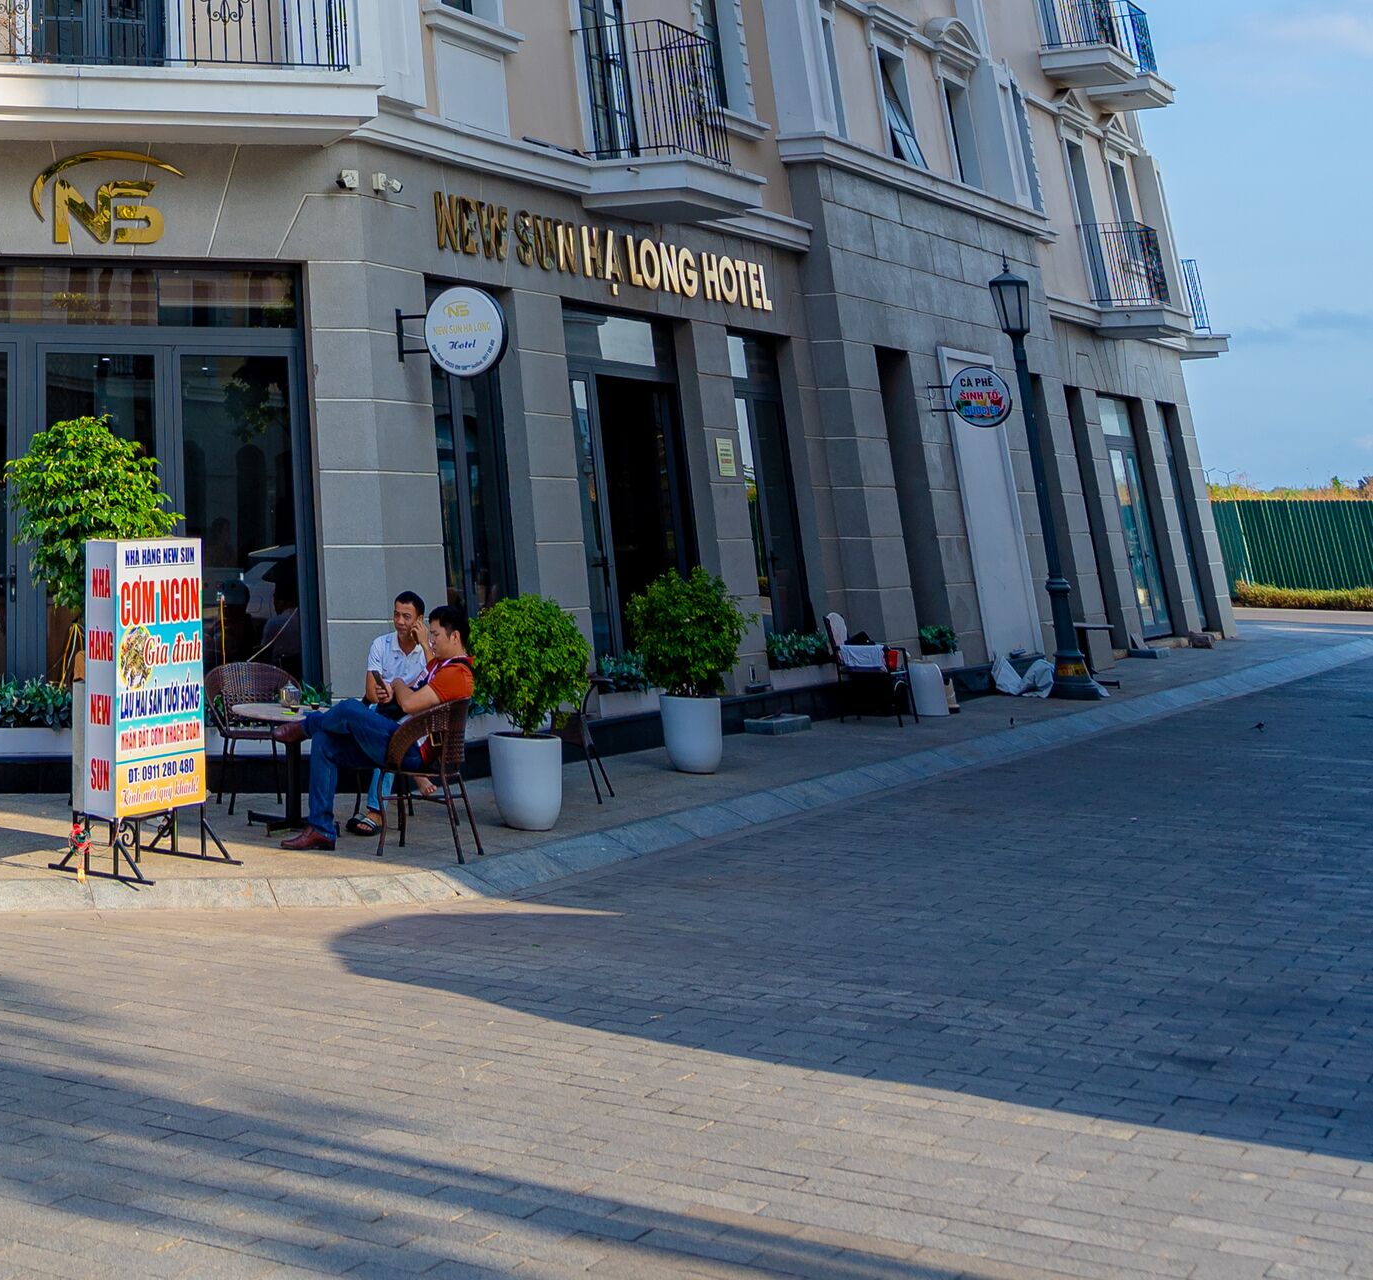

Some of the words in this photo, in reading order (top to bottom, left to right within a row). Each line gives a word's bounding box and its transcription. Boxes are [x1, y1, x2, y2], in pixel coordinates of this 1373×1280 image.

[433, 191, 508, 261] NEW
[515, 210, 578, 274] SUN
[580, 225, 626, 296] HẠ
[625, 234, 699, 299] LONG
[701, 251, 773, 312] HOTEL
[448, 338, 477, 350] Hotel
[124, 546, 140, 566] NHÀ
[141, 546, 162, 565] HÀNG
[163, 546, 179, 563] NEW
[180, 546, 195, 563] SUN
[92, 563, 111, 599] NHÀ
[120, 574, 156, 627] CƠM
[160, 577, 200, 623] NGON
[88, 626, 114, 662] HÀNG
[144, 636, 169, 666] Gia
[172, 631, 202, 664] đình
[180, 671, 200, 712] SỐNG
[90, 693, 112, 726] NEW
[90, 758, 110, 792] SUN
[142, 763, 160, 781] 0911
[162, 760, 177, 778] 280
[179, 757, 195, 774] 480
